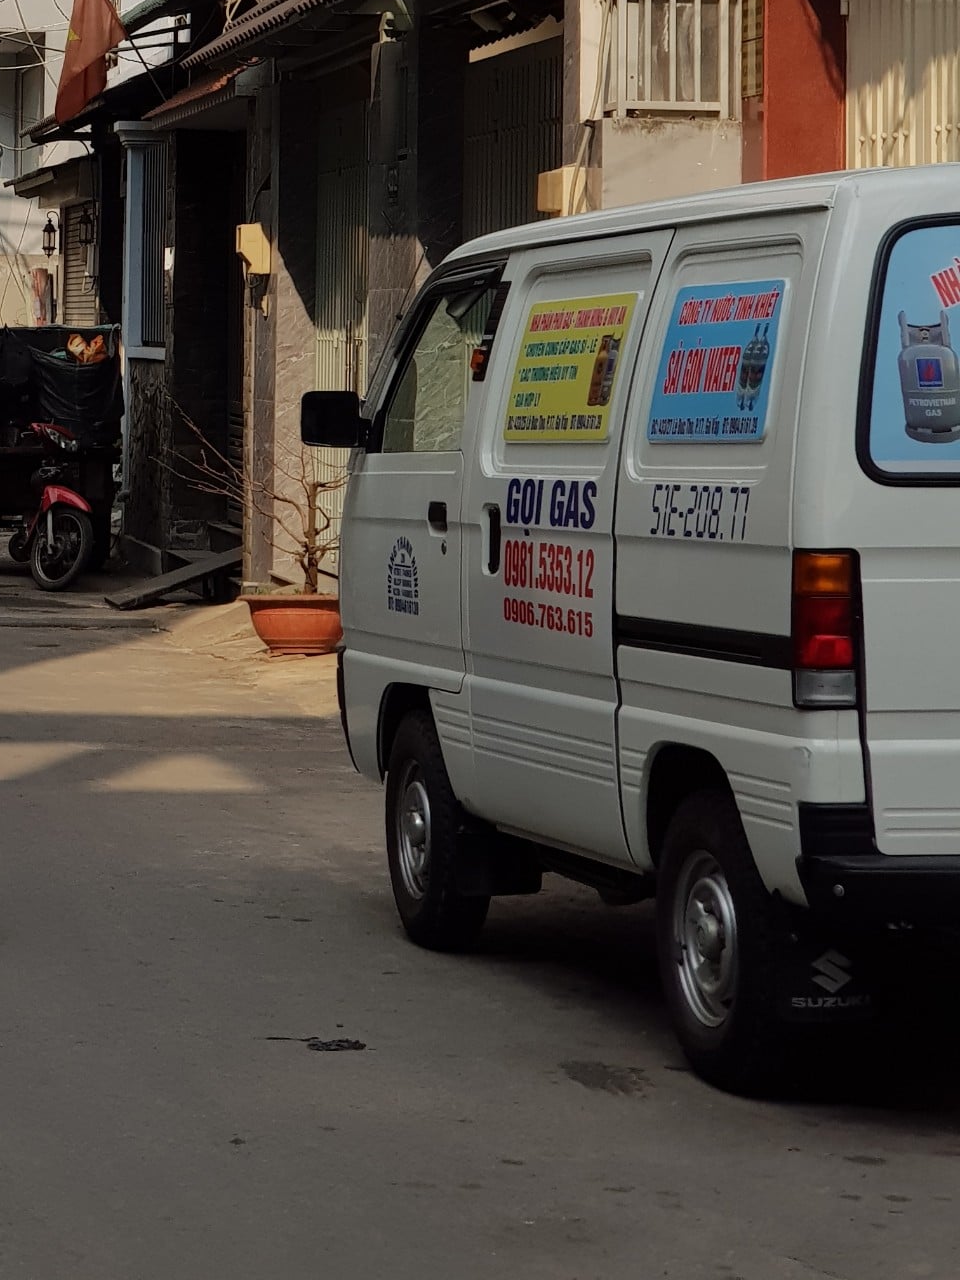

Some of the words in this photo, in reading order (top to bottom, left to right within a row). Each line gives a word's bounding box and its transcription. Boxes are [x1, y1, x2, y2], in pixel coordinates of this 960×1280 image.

[931, 258, 960, 308] NH
[679, 297, 702, 326] CÔNG
[700, 300, 713, 324] TY
[734, 296, 755, 321] TINH
[703, 346, 742, 393] WATER
[925, 409, 942, 417] GAS
[506, 478, 544, 536] GỌI
[549, 480, 597, 529] GAS
[504, 540, 594, 599] 0981.5353.12
[504, 597, 593, 638] 0906.763.615
[791, 995, 871, 1008] SUZUKI
